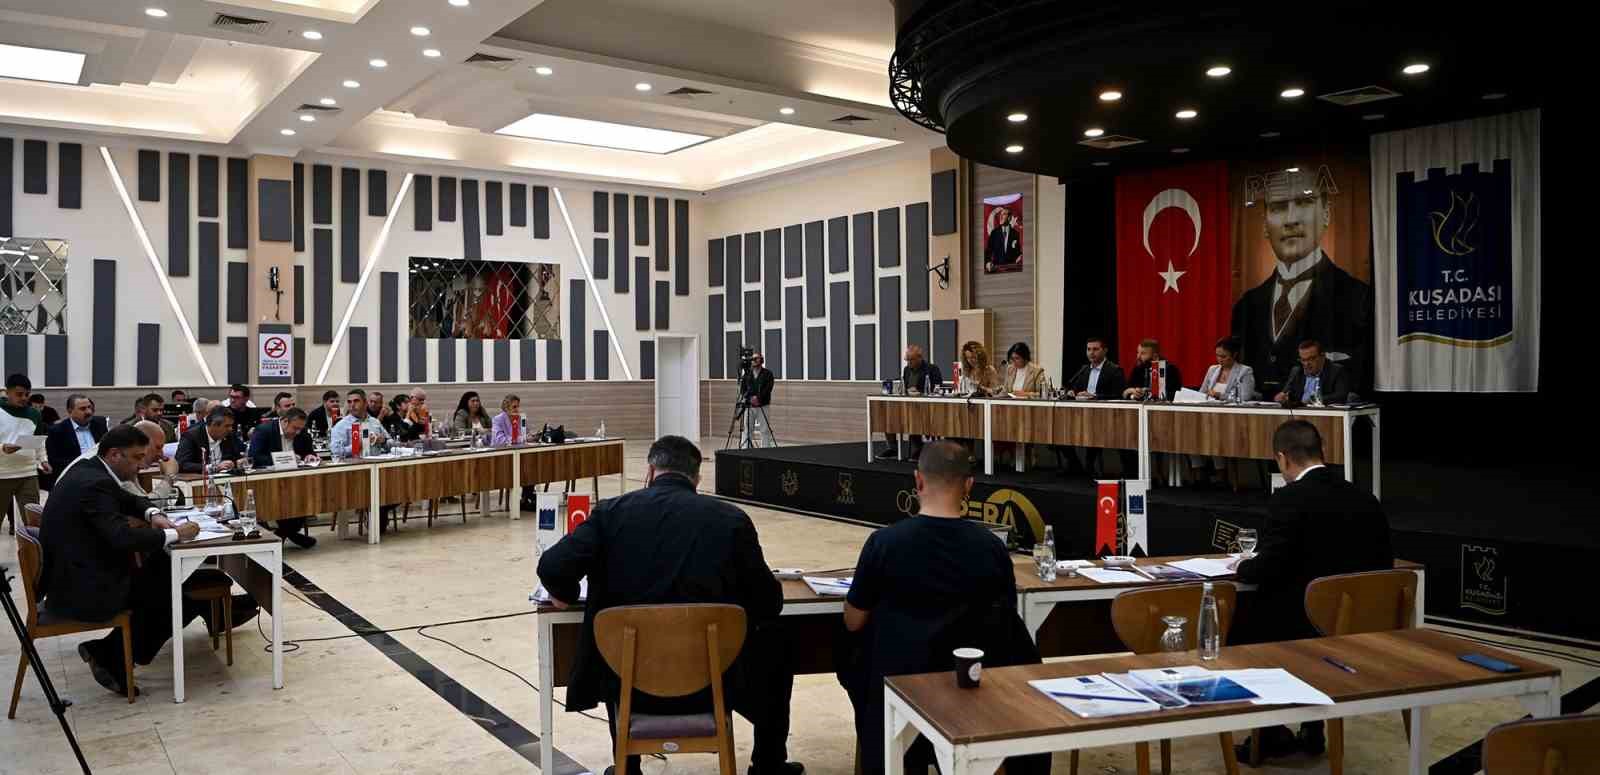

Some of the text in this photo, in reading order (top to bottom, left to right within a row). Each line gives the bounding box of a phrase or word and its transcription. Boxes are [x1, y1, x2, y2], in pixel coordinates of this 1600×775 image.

[1440, 268, 1470, 284] T.C.
[1408, 285, 1503, 306] KUŞADASI
[1408, 304, 1502, 322] BELEDİYESİ
